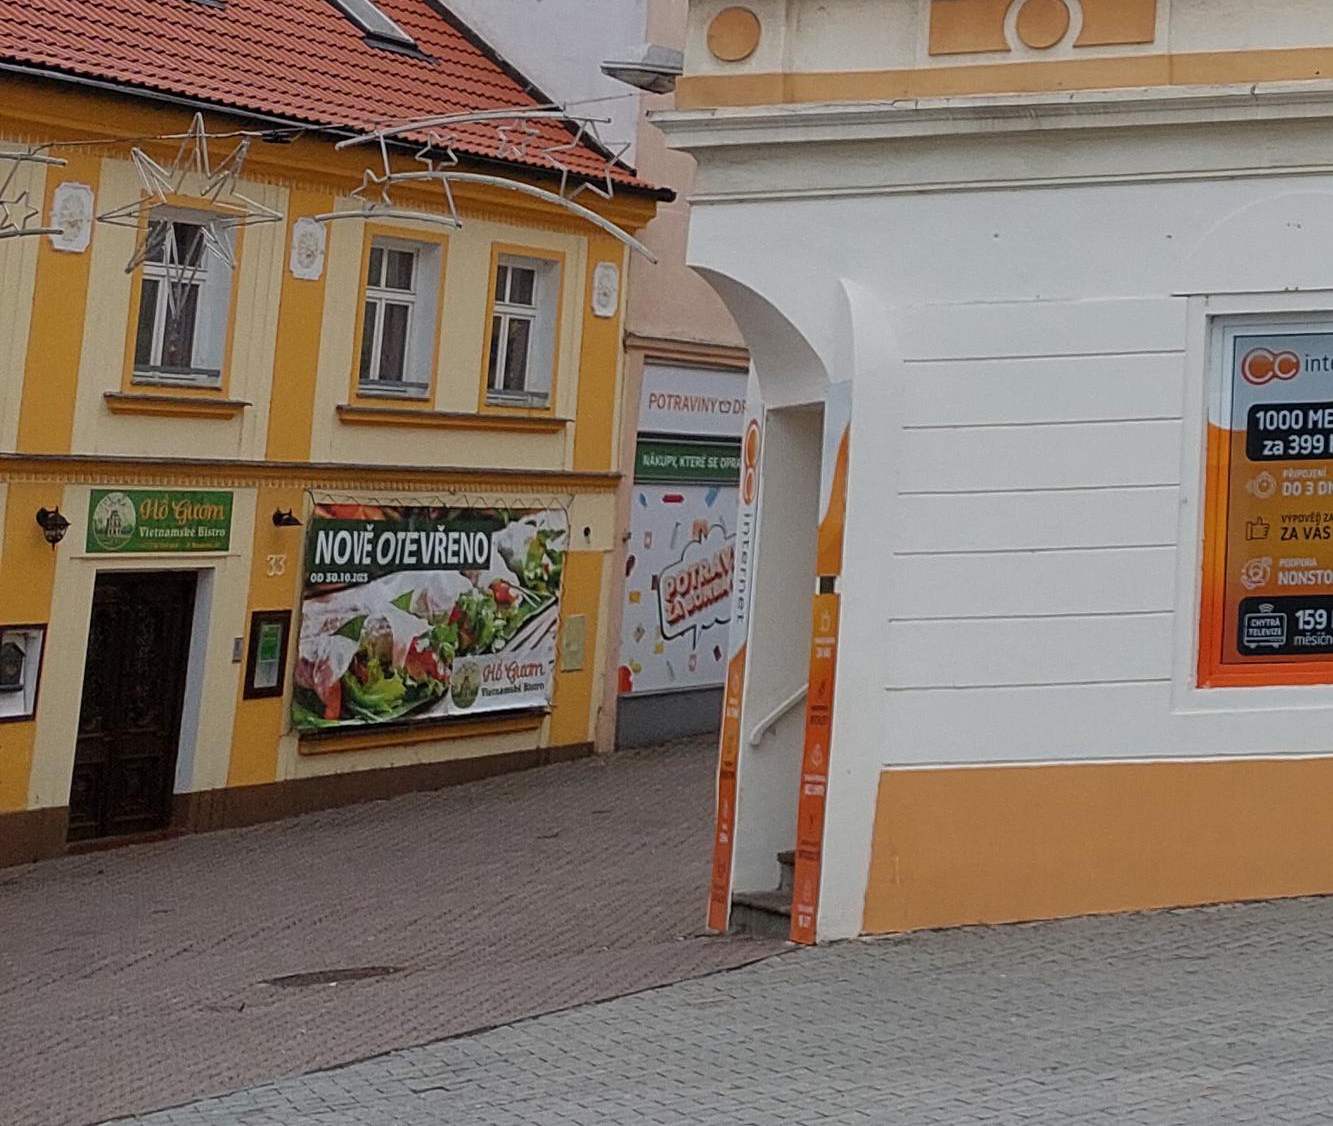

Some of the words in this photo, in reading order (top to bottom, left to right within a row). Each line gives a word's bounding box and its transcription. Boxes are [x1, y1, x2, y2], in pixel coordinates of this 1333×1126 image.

[648, 392, 718, 414] POTRAVINY
[1255, 409, 1304, 431] 1000
[1262, 439, 1284, 456] za
[1287, 434, 1325, 455] 399
[707, 456, 719, 469] SE
[1282, 480, 1302, 496] DO
[1305, 480, 1315, 495] 3
[139, 526, 196, 538] Vietnamské
[197, 525, 226, 538] Bistro
[1281, 526, 1298, 541] ZA
[1303, 523, 1332, 541] VÁS
[315, 524, 374, 566] NOVĚ
[376, 524, 490, 566] OTEVŘENO
[265, 553, 288, 576] 33
[310, 572, 323, 584] OD
[1295, 609, 1328, 630] 159
